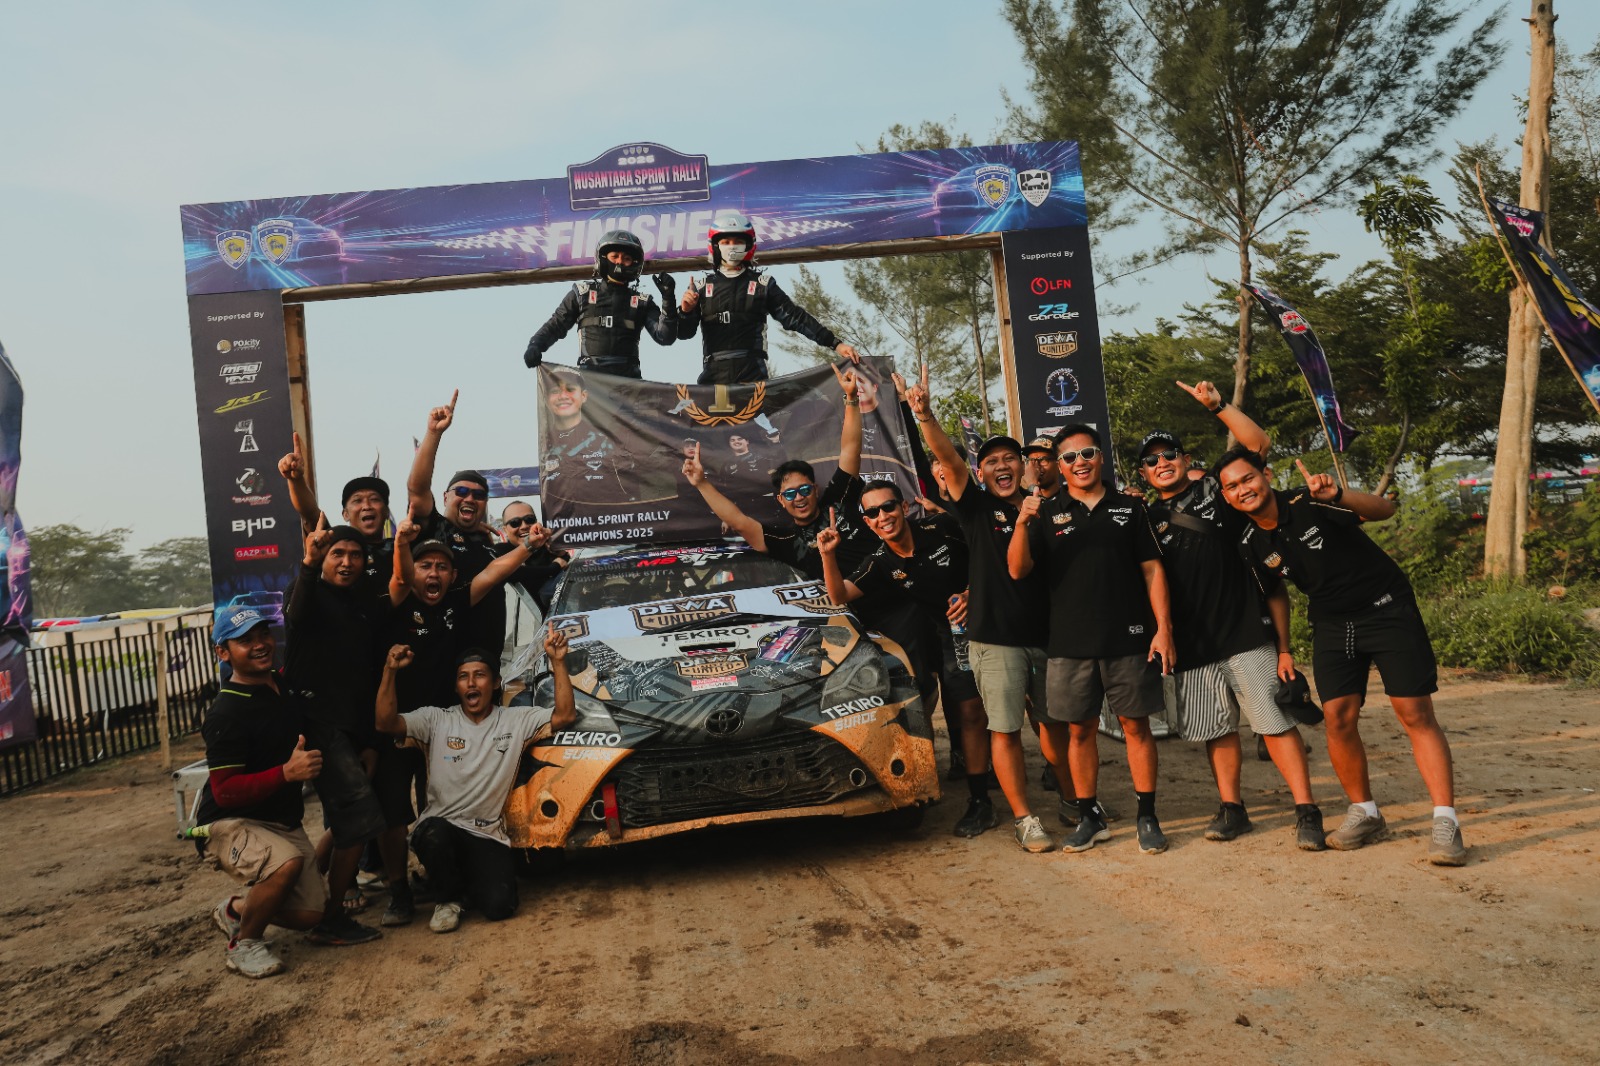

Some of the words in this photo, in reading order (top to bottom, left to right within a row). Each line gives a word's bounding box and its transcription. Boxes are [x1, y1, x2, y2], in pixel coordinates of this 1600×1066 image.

[573, 170, 633, 190] NUSANTARA
[634, 166, 671, 186] SPRINT
[672, 161, 701, 181] RALLY
[547, 208, 742, 261] FINSHE
[1021, 251, 1062, 261] Supported
[1064, 250, 1074, 258] By
[1050, 279, 1072, 290] LFN
[207, 312, 251, 322] Supported
[253, 311, 264, 319] By
[1028, 312, 1079, 321] Garage
[1039, 303, 1068, 315] 73
[1038, 333, 1075, 345] DEWA
[1046, 343, 1070, 354] UNITED
[231, 517, 276, 538] BHD
[546, 515, 595, 529] NATIONAL
[597, 513, 635, 526] SPRINT
[637, 511, 670, 522] RALLY
[563, 529, 624, 543] CHAMPIONS
[626, 527, 654, 538] 2025
[636, 556, 678, 567] MS
[638, 598, 728, 615] DEWA
[657, 611, 716, 626] UNITED
[658, 627, 750, 642] TEKIRO
[821, 695, 884, 720] TEKIRO
[553, 731, 622, 747] TEKIRO
